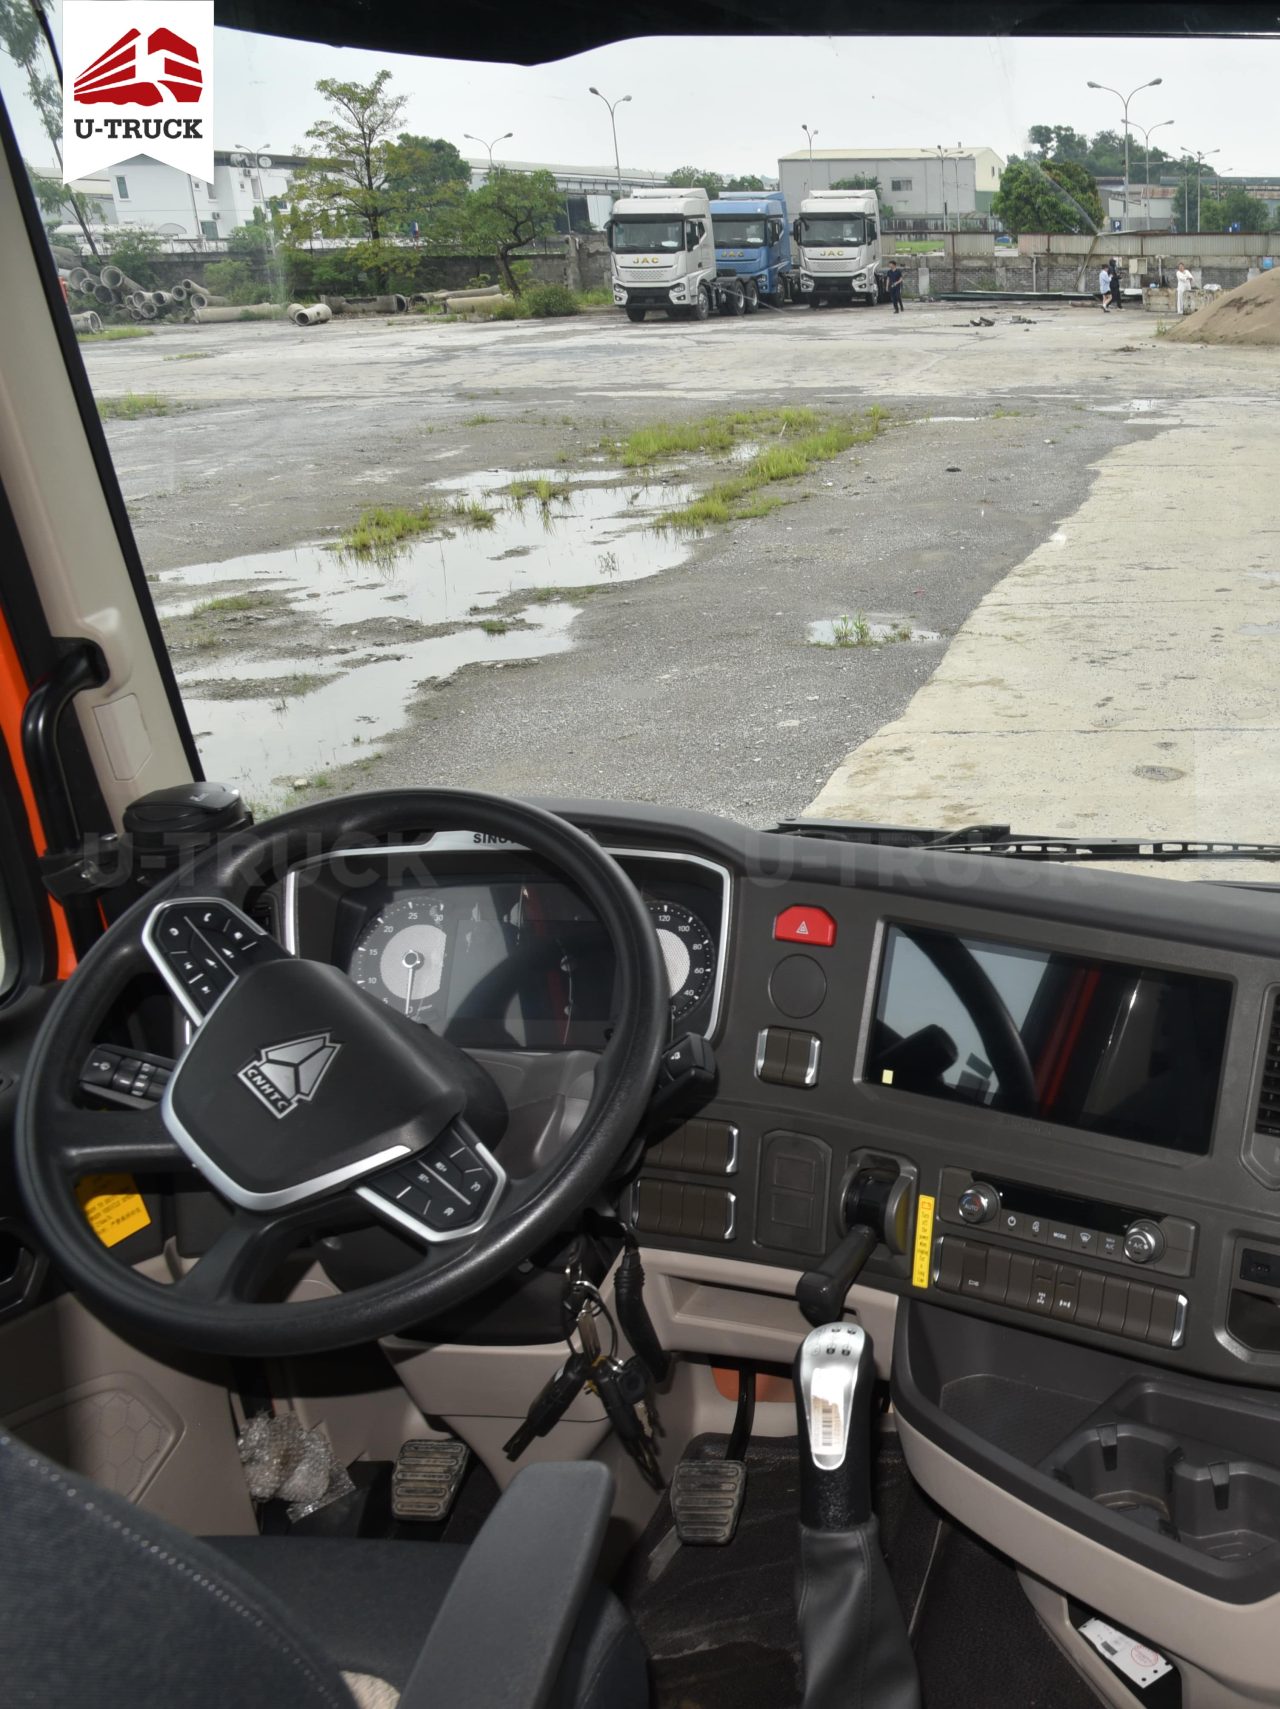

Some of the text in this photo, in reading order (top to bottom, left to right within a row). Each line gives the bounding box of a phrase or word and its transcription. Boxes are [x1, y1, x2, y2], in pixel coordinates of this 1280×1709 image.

[632, 256, 659, 264] JAC
[408, 912, 418, 920] 25
[383, 925, 394, 933] 20
[369, 948, 378, 956] 15
[246, 1068, 289, 1110] CNHTC
[964, 1203, 978, 1211] AUTO
[1053, 1232, 1067, 1240] MODE
